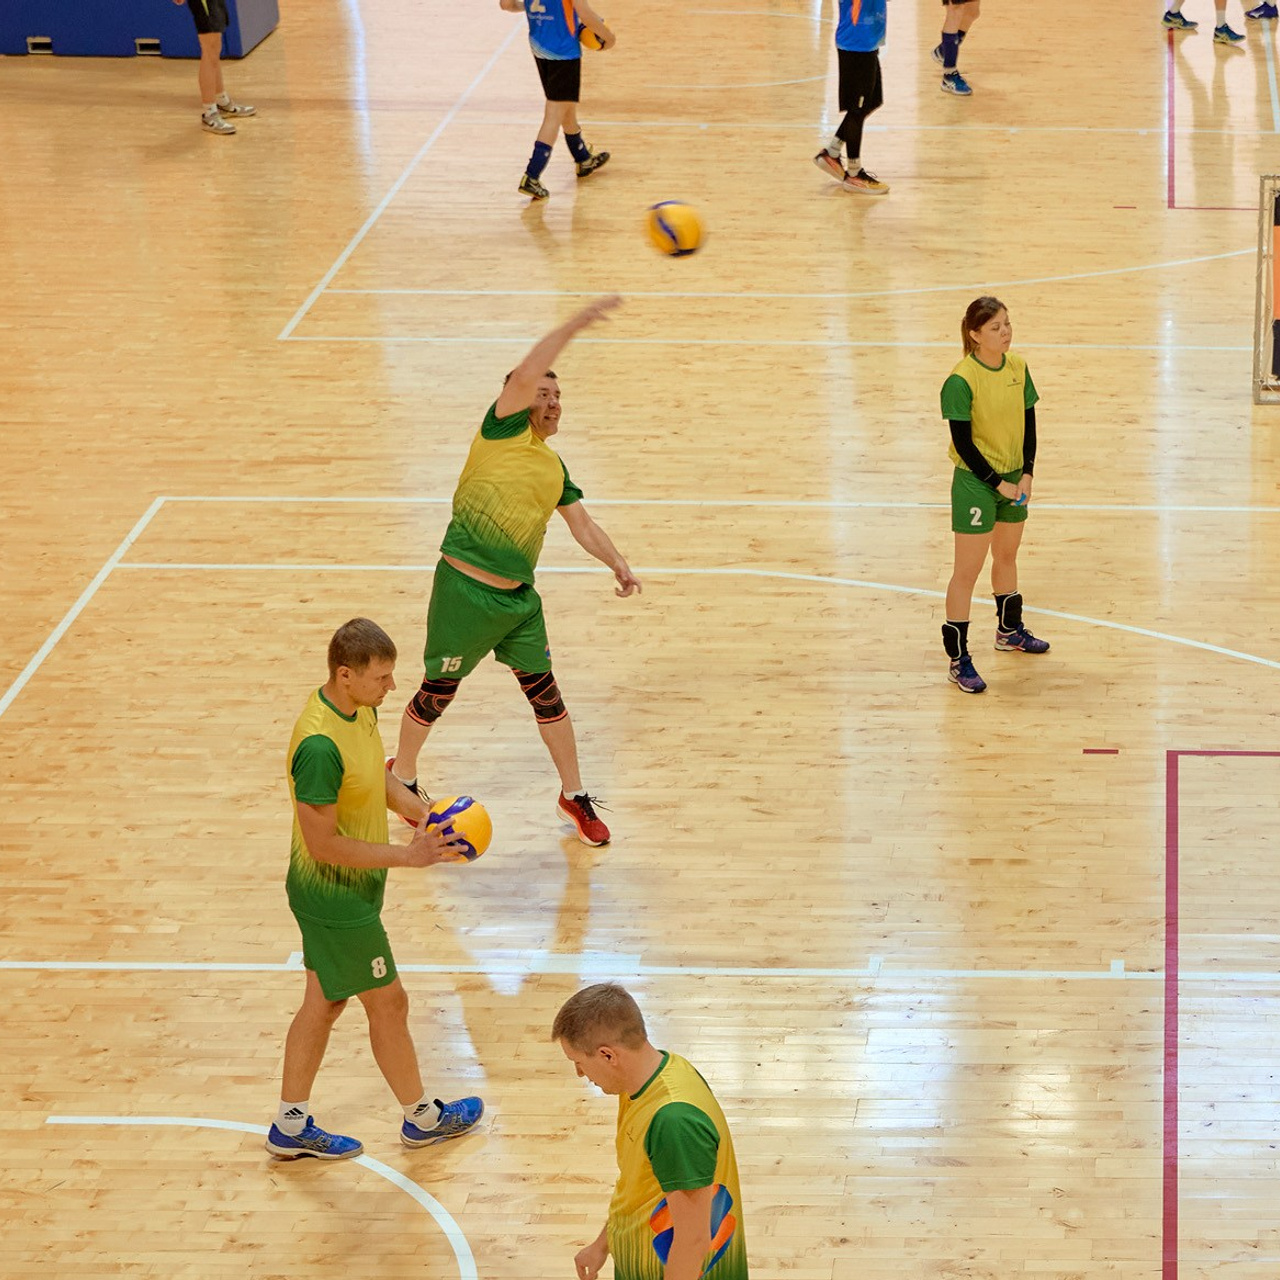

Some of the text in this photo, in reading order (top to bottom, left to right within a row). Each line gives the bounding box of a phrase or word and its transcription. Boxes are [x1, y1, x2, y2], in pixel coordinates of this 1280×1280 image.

[969, 507, 982, 526] 2
[440, 656, 463, 673] 15
[371, 956, 387, 979] 8
